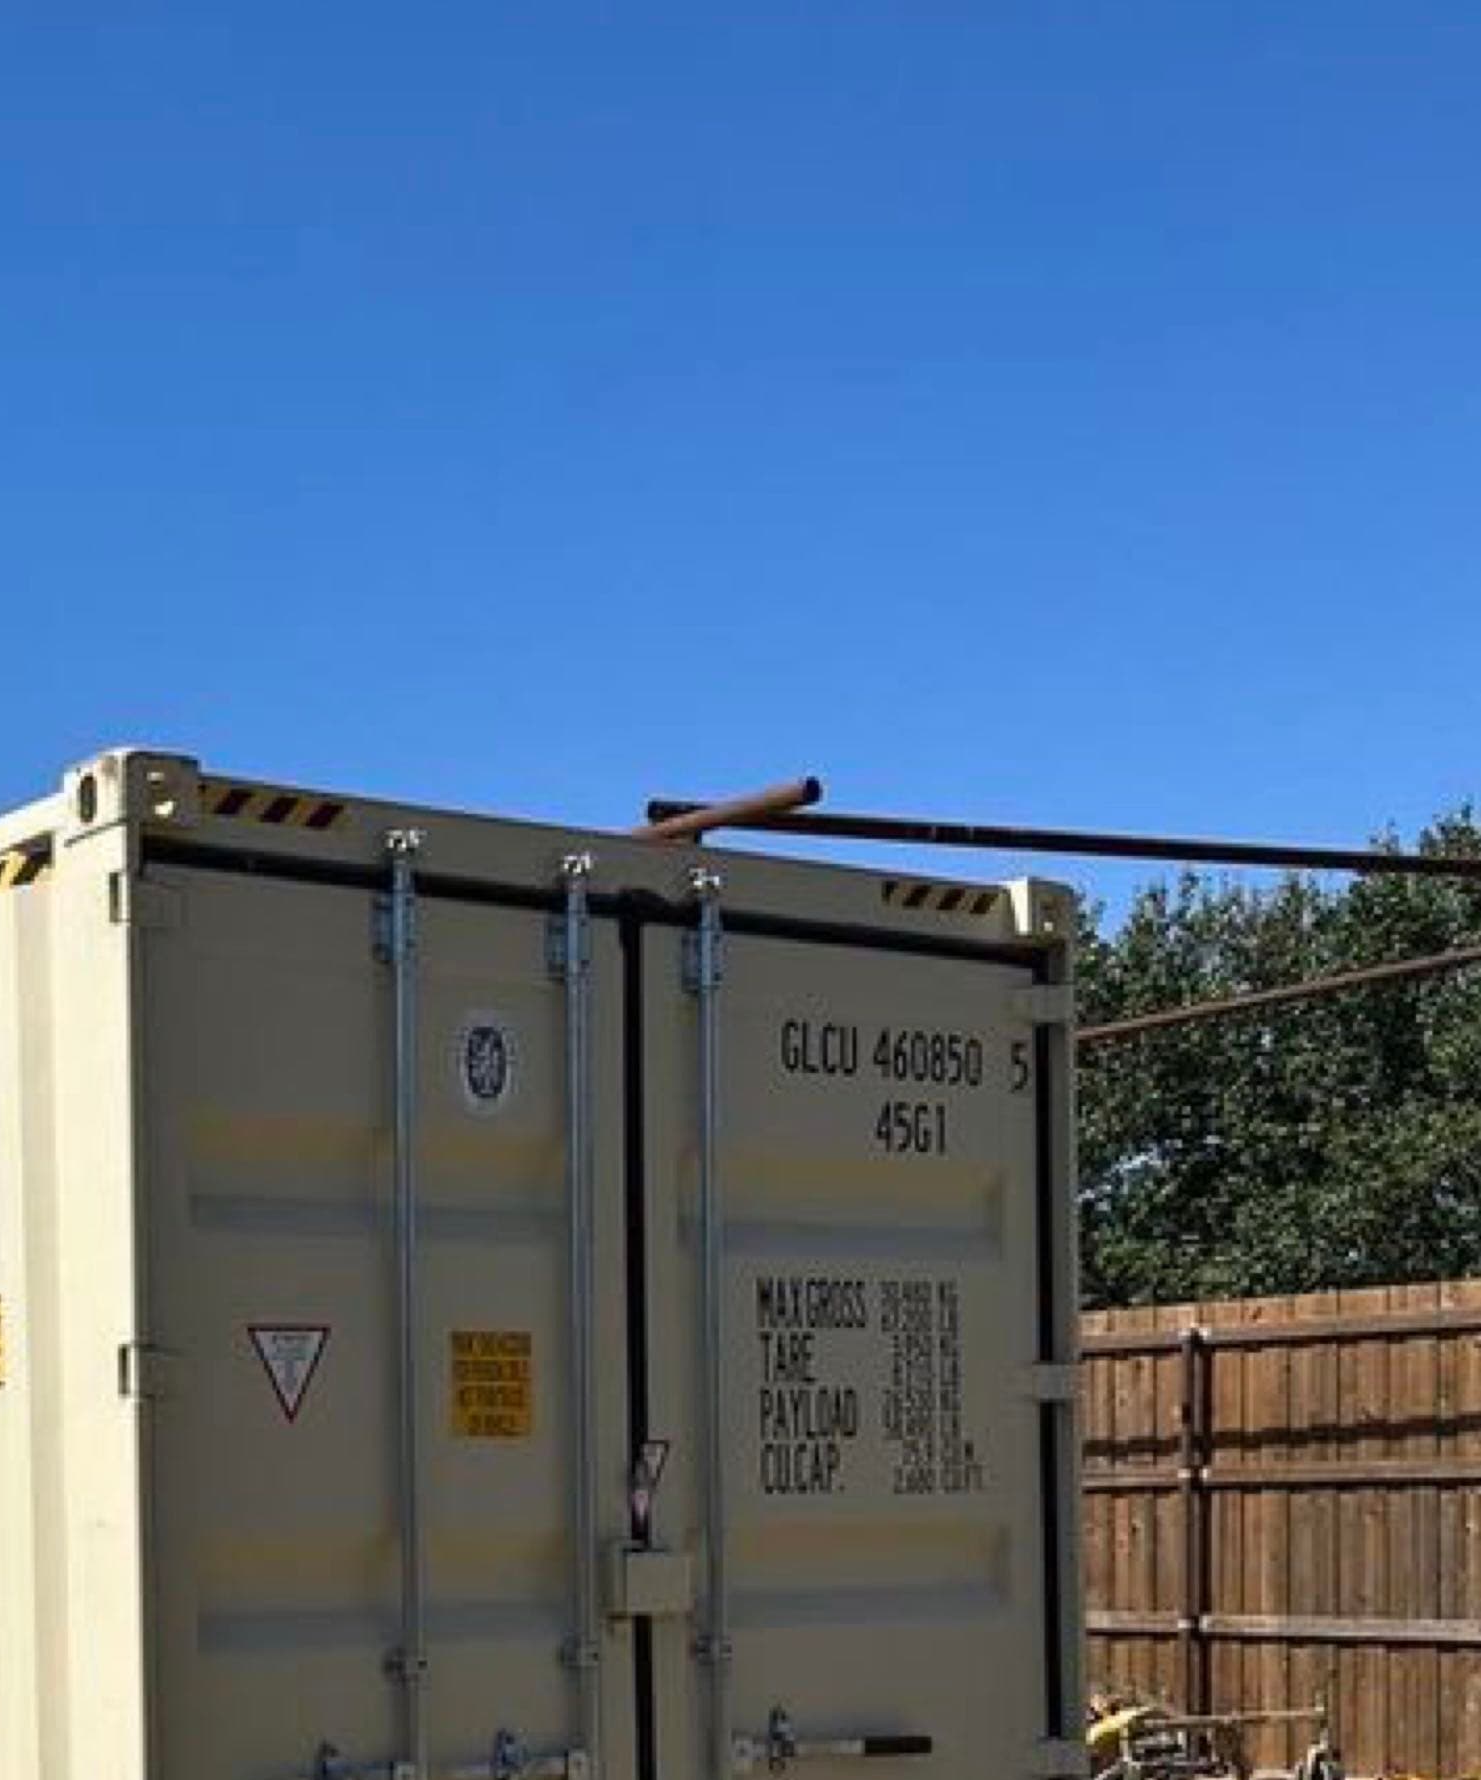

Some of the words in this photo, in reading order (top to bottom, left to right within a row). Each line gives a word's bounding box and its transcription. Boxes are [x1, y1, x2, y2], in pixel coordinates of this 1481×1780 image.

[780, 1019, 858, 1076] GLCU
[872, 1027, 983, 1087] 460850
[1010, 1041, 1029, 1093] 5
[875, 1100, 947, 1154] 45G1
[760, 1331, 816, 1383] TARE
[760, 1387, 857, 1439] PAYLOAD
